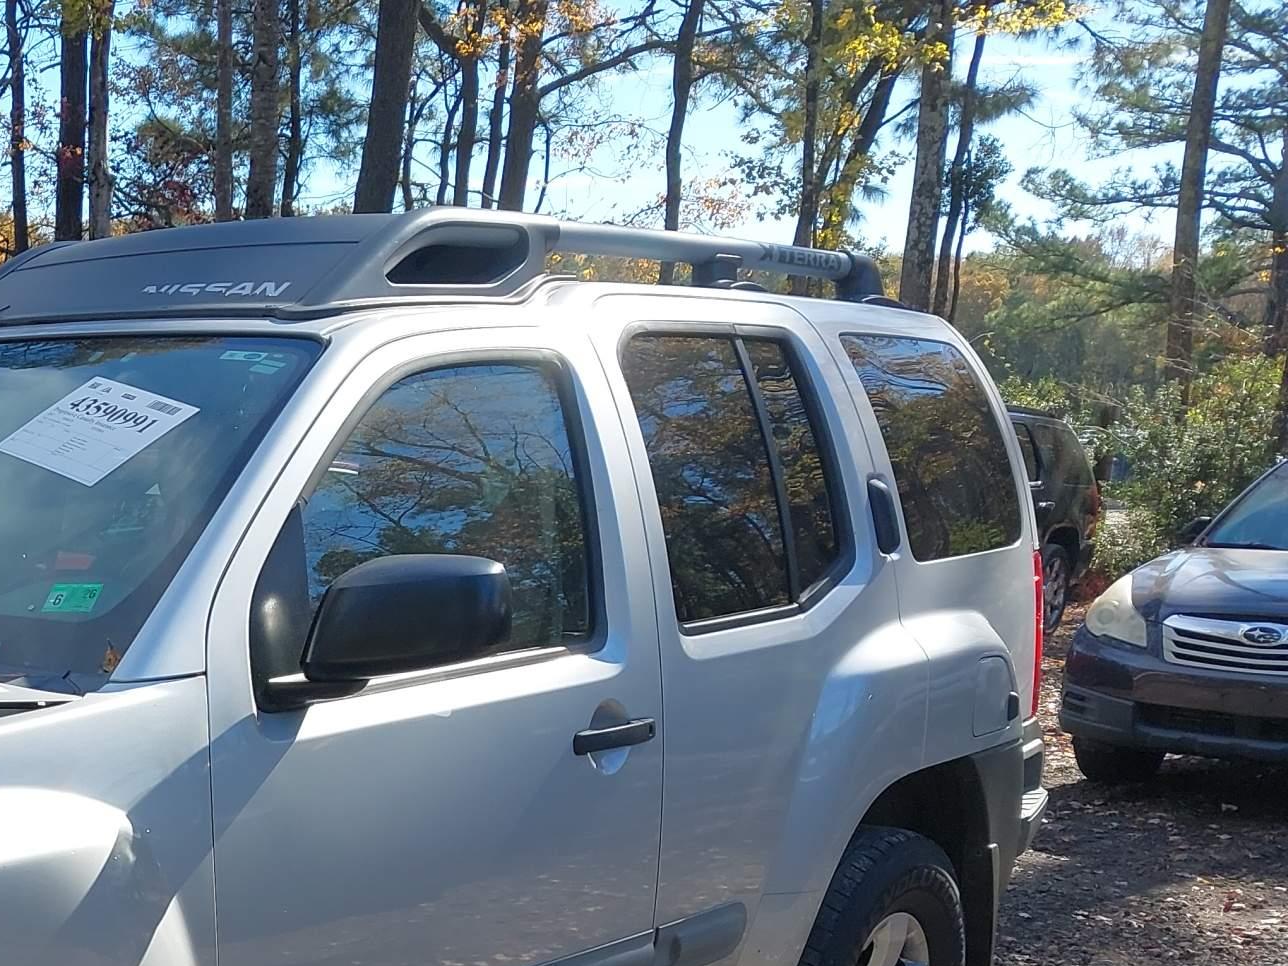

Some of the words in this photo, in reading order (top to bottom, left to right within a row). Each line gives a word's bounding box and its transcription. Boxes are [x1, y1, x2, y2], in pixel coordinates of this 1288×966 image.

[142, 281, 292, 297] NISSAN
[69, 396, 159, 433] 43590991
[53, 593, 64, 606] 6
